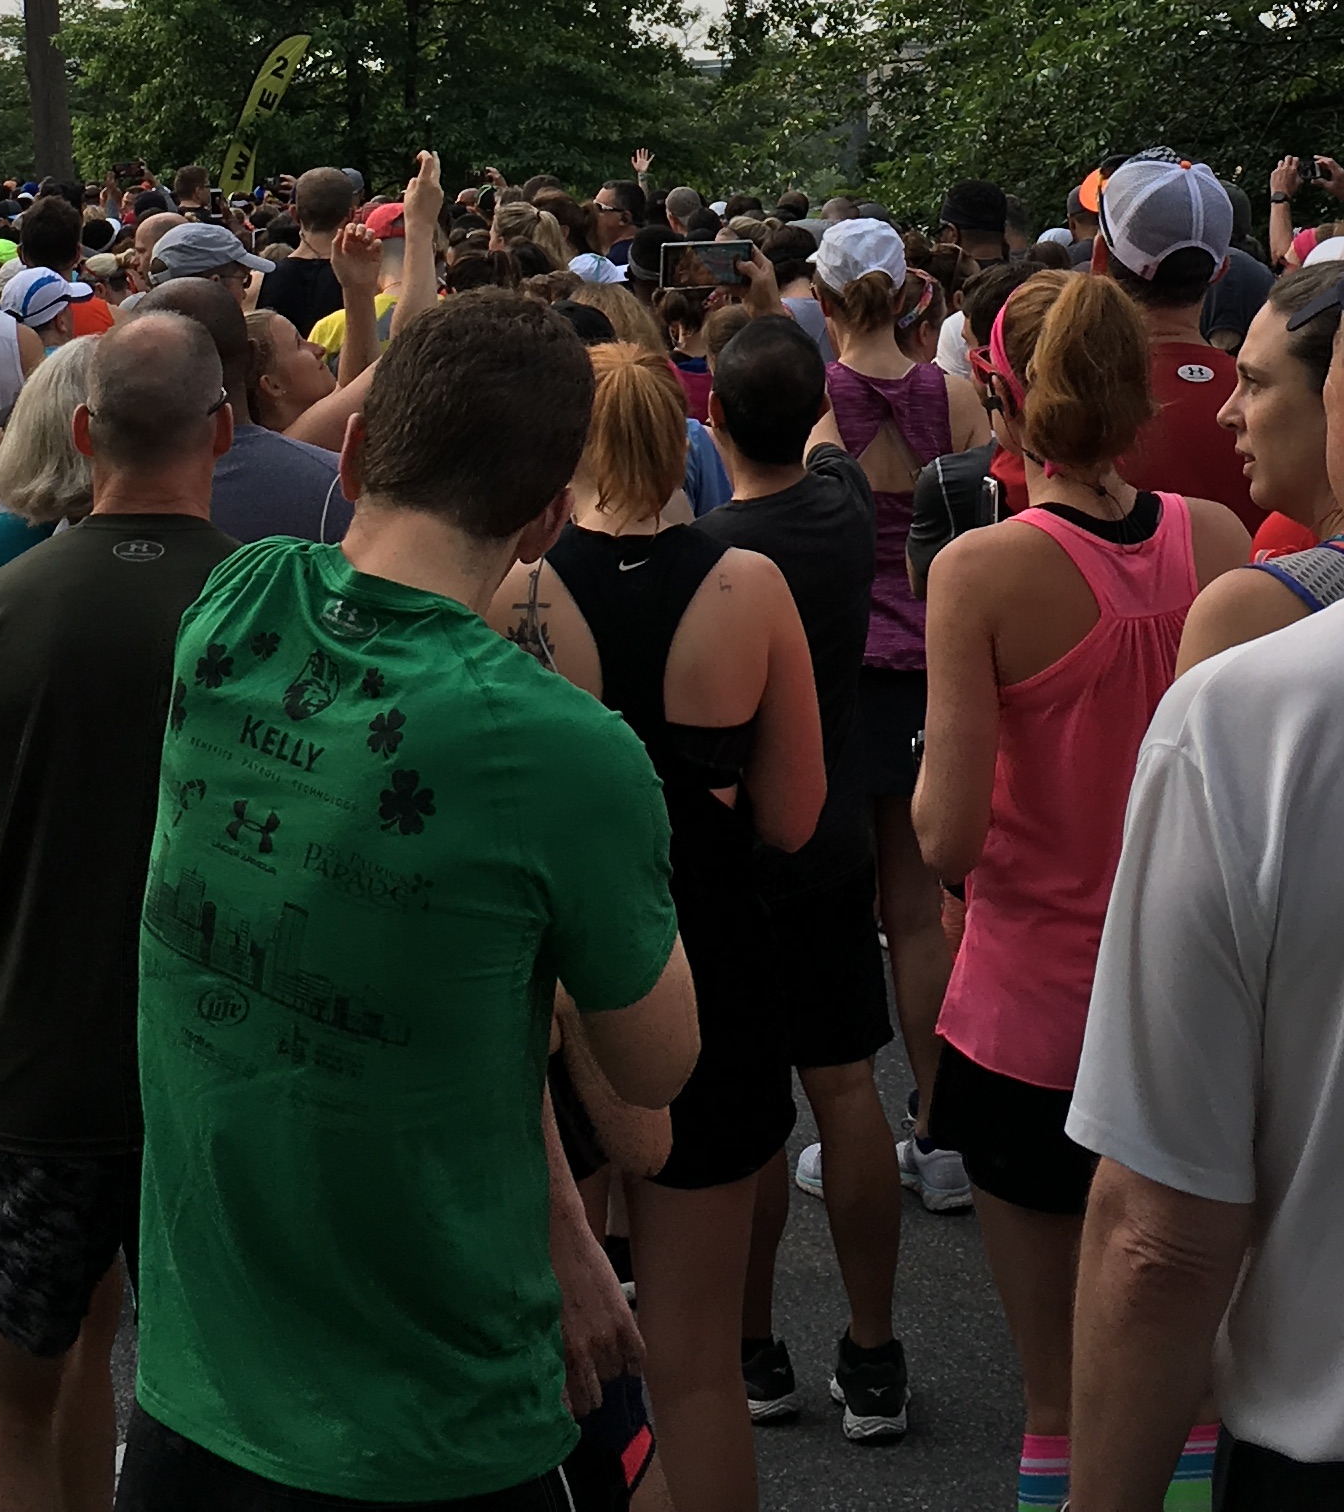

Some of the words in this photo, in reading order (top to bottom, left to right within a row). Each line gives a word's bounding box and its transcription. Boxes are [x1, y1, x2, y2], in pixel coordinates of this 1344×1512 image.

[231, 88, 278, 182] WE
[271, 56, 288, 79] 2
[190, 736, 233, 761] BENEFITS
[242, 758, 281, 784] PAYROLL
[239, 714, 326, 772] KELLY
